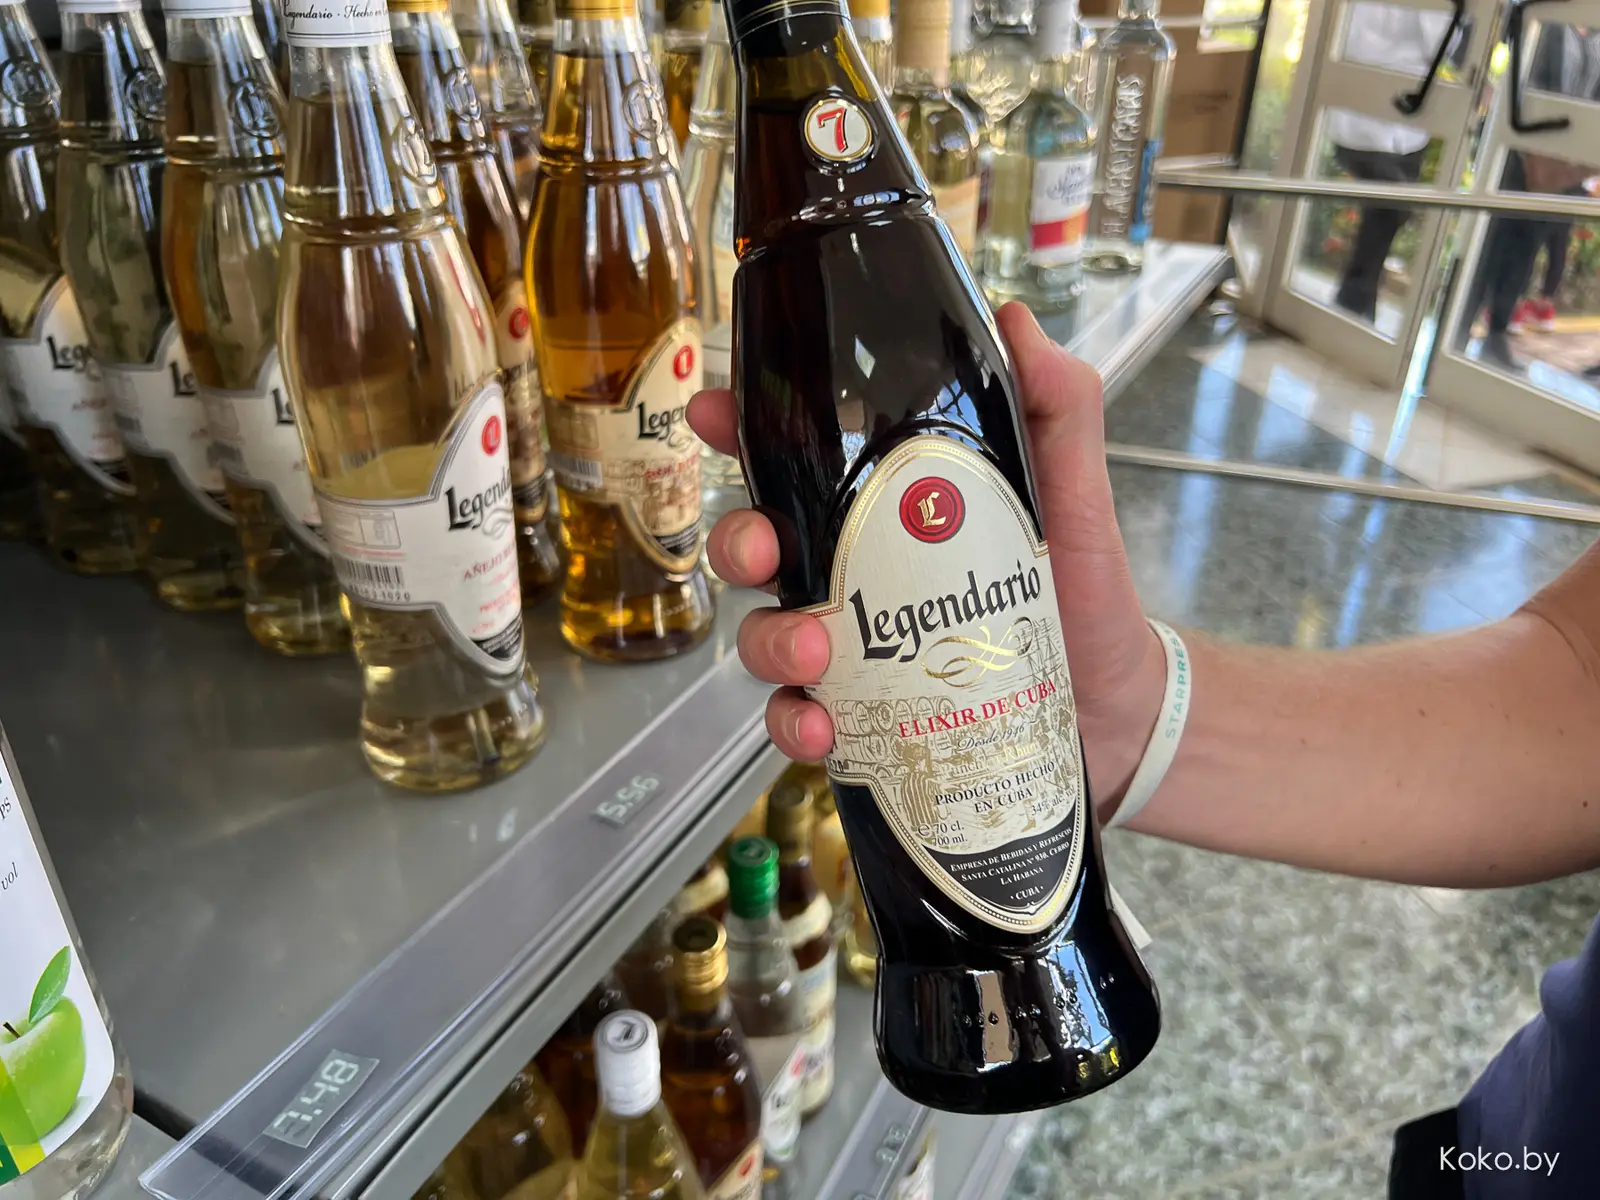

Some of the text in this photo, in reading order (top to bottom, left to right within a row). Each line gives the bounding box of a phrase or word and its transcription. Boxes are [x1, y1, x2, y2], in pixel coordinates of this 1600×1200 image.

[816, 107, 848, 153] 7
[848, 559, 1041, 662] Legendario
[899, 679, 1058, 739] ELIXIR DE CUBA
[957, 724, 1026, 752] Desde 1946
[934, 760, 1056, 806] PRODUCTO HECHO
[974, 787, 1034, 814] EN CUBA
[933, 833, 968, 847] 700 ml.
[934, 822, 948, 835] 70
[950, 820, 965, 833] cl.
[950, 827, 1073, 873] EMPRESA DE BEBIDAS Y REFRESCOS
[961, 870, 987, 882] SANTA
[988, 860, 1027, 877] CATALINA
[1049, 841, 1070, 857] CERRO
[1, 861, 18, 890] vol
[1000, 866, 1044, 886] LA HABANA
[1015, 885, 1042, 901] CUBA
[273, 1058, 359, 1129] 7.48
